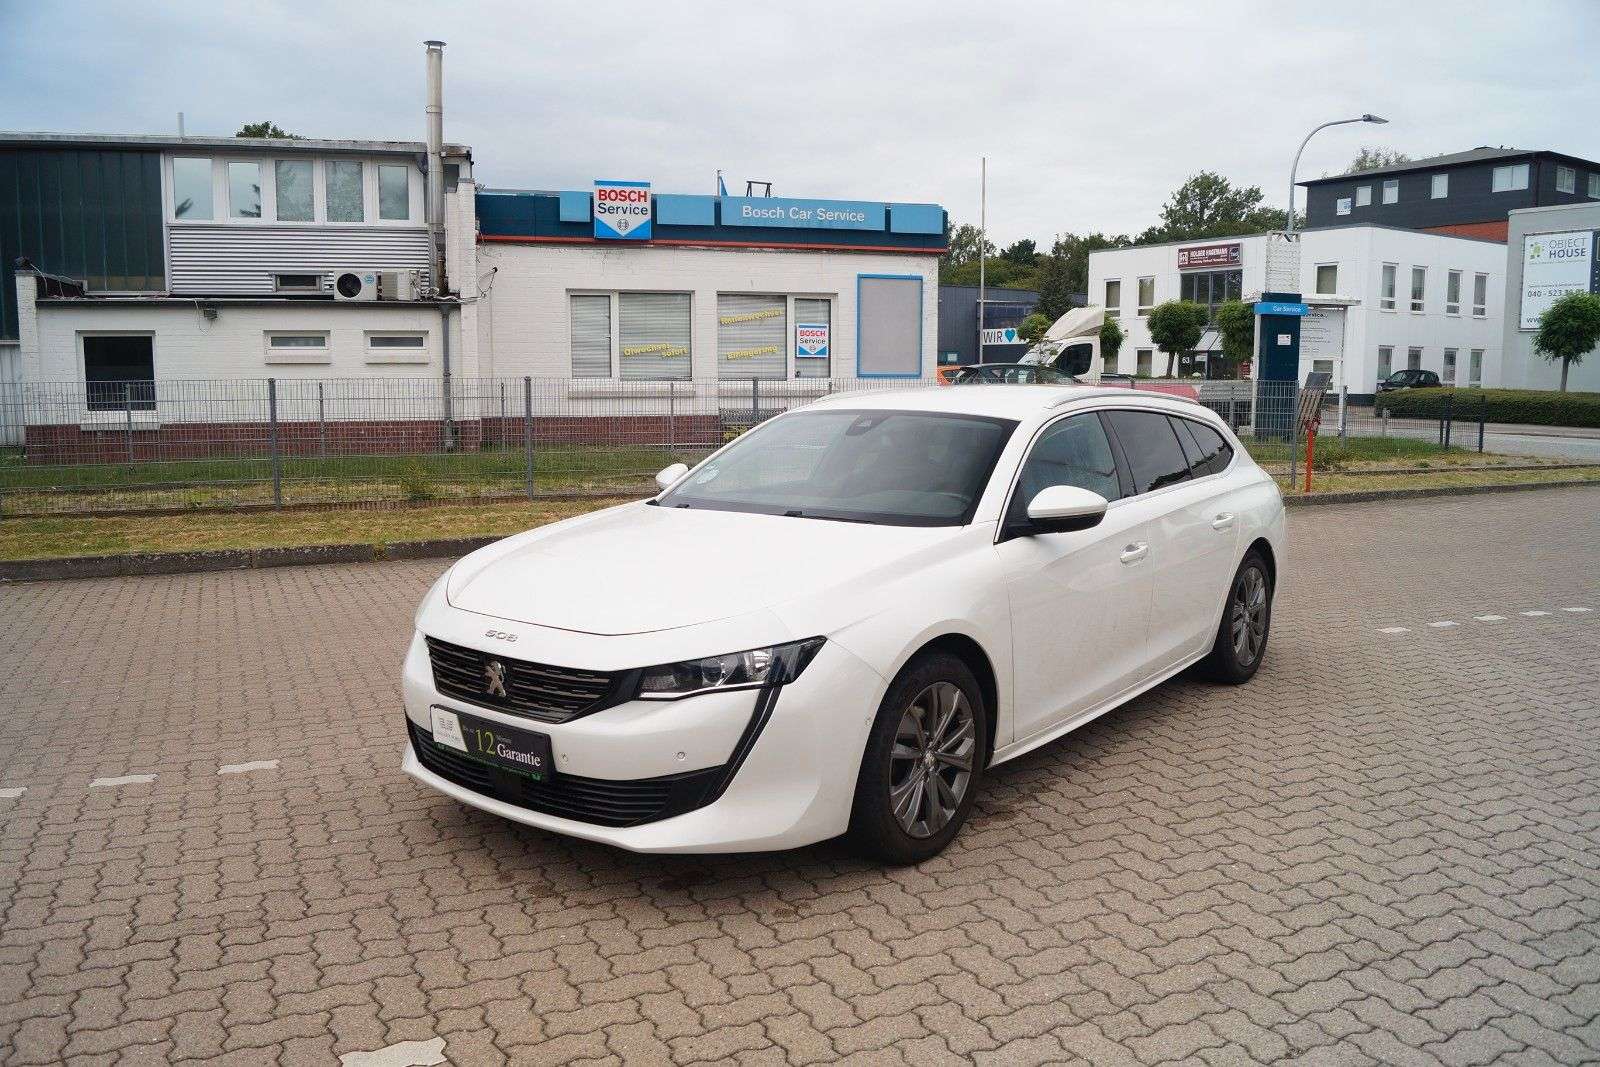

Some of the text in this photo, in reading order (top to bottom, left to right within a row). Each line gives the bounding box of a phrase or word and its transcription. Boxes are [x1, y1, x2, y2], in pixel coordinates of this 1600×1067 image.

[598, 189, 648, 202] BOSCH
[597, 202, 648, 216] Service
[742, 205, 866, 222] Bosch Car Service
[1549, 238, 1586, 249] OBJECT
[1549, 248, 1587, 258] HOUSE
[1527, 289, 1542, 298] 040
[1548, 289, 1562, 297] 523
[799, 329, 826, 337] BOSCH
[983, 331, 1003, 343] WIR
[799, 337, 826, 345] Service
[485, 629, 518, 643] 508
[474, 729, 496, 755] 12
[497, 743, 541, 767] Garantie
